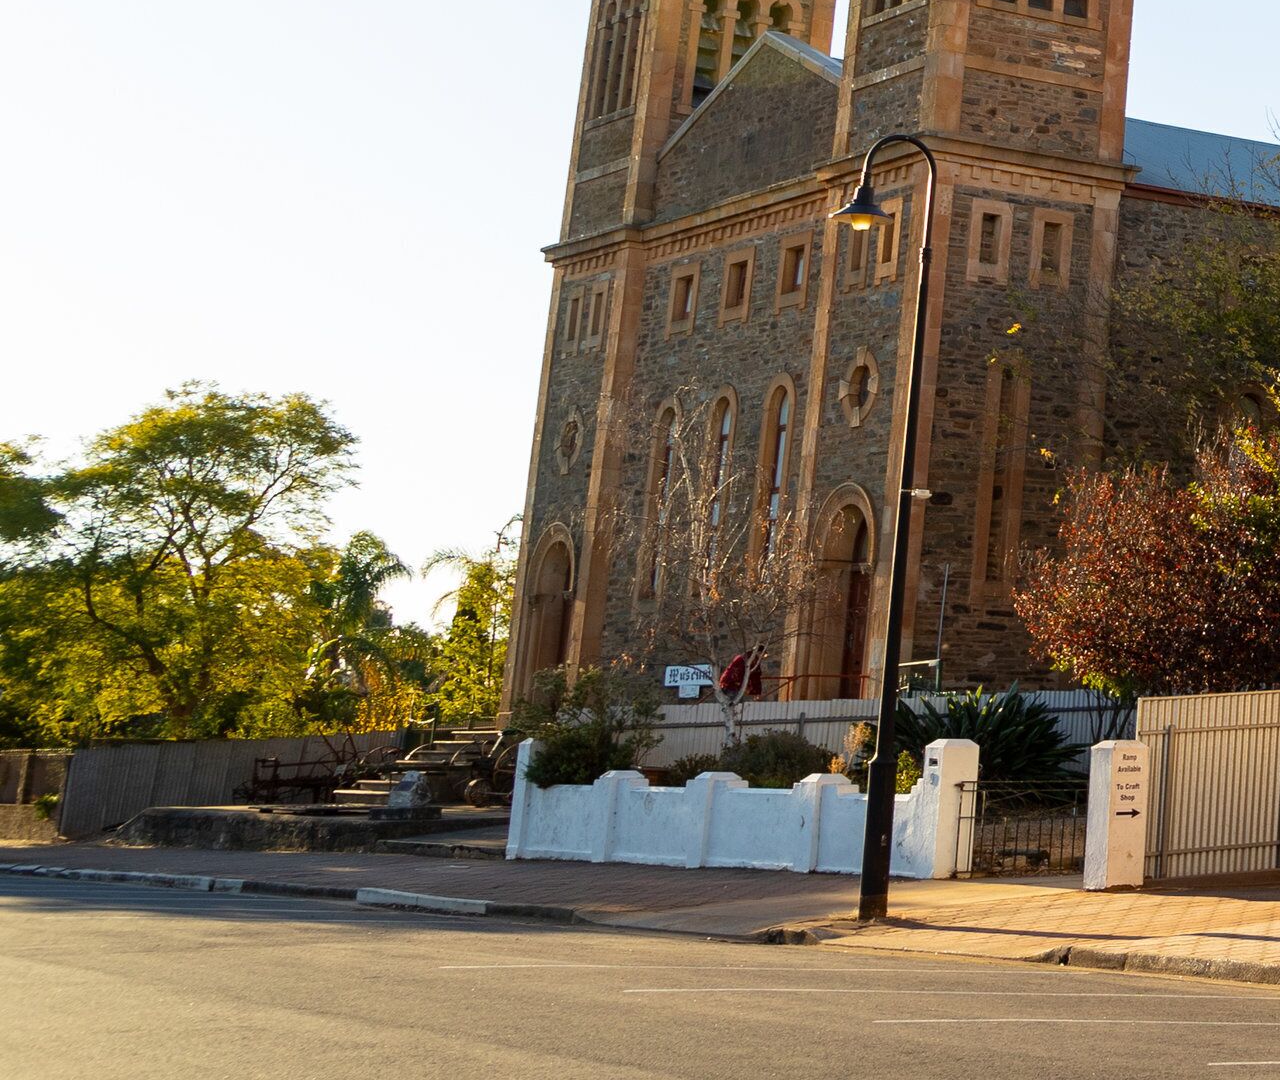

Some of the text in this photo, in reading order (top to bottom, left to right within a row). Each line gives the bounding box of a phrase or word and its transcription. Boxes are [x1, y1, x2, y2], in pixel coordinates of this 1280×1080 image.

[1122, 753, 1138, 762] Ramp
[1117, 765, 1142, 773] Available
[1120, 794, 1135, 802] Shop
